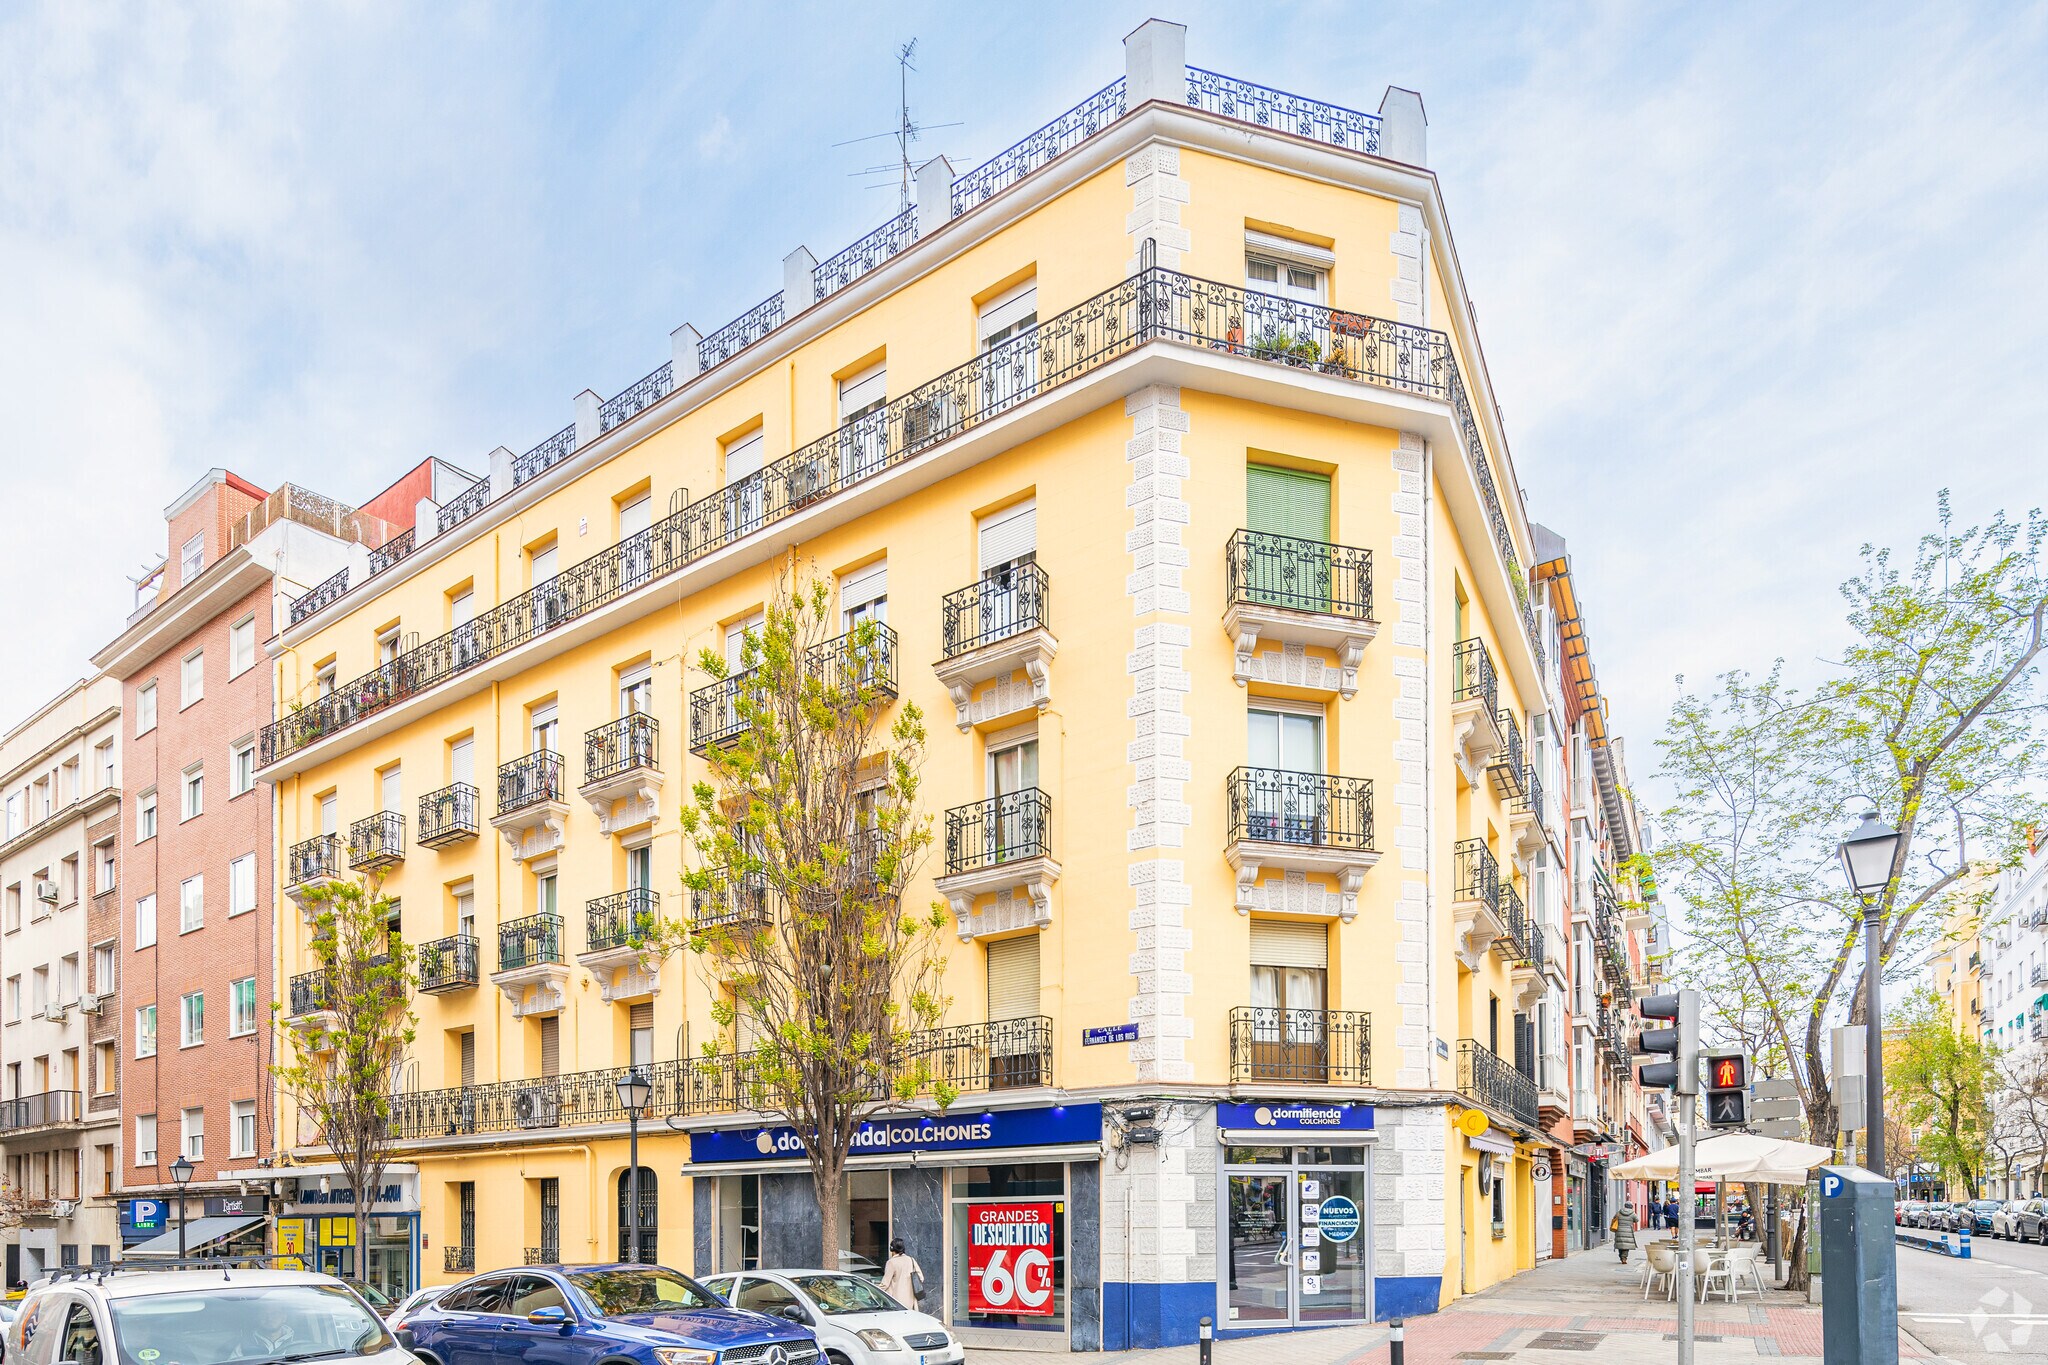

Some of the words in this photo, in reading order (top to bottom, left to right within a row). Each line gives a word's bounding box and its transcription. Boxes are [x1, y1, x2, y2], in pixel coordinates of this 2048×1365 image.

[1109, 1034, 1115, 1043] DE
[1116, 1033, 1124, 1042] LOS
[1273, 1107, 1341, 1119] dormitienda
[890, 1123, 992, 1145] COLCHONES
[1824, 1176, 1840, 1197] P
[135, 1201, 157, 1222] P
[980, 1210, 1039, 1223] GRANDES
[1323, 1207, 1354, 1215] NUEVOS
[974, 1222, 1048, 1246] DESCUENTOS
